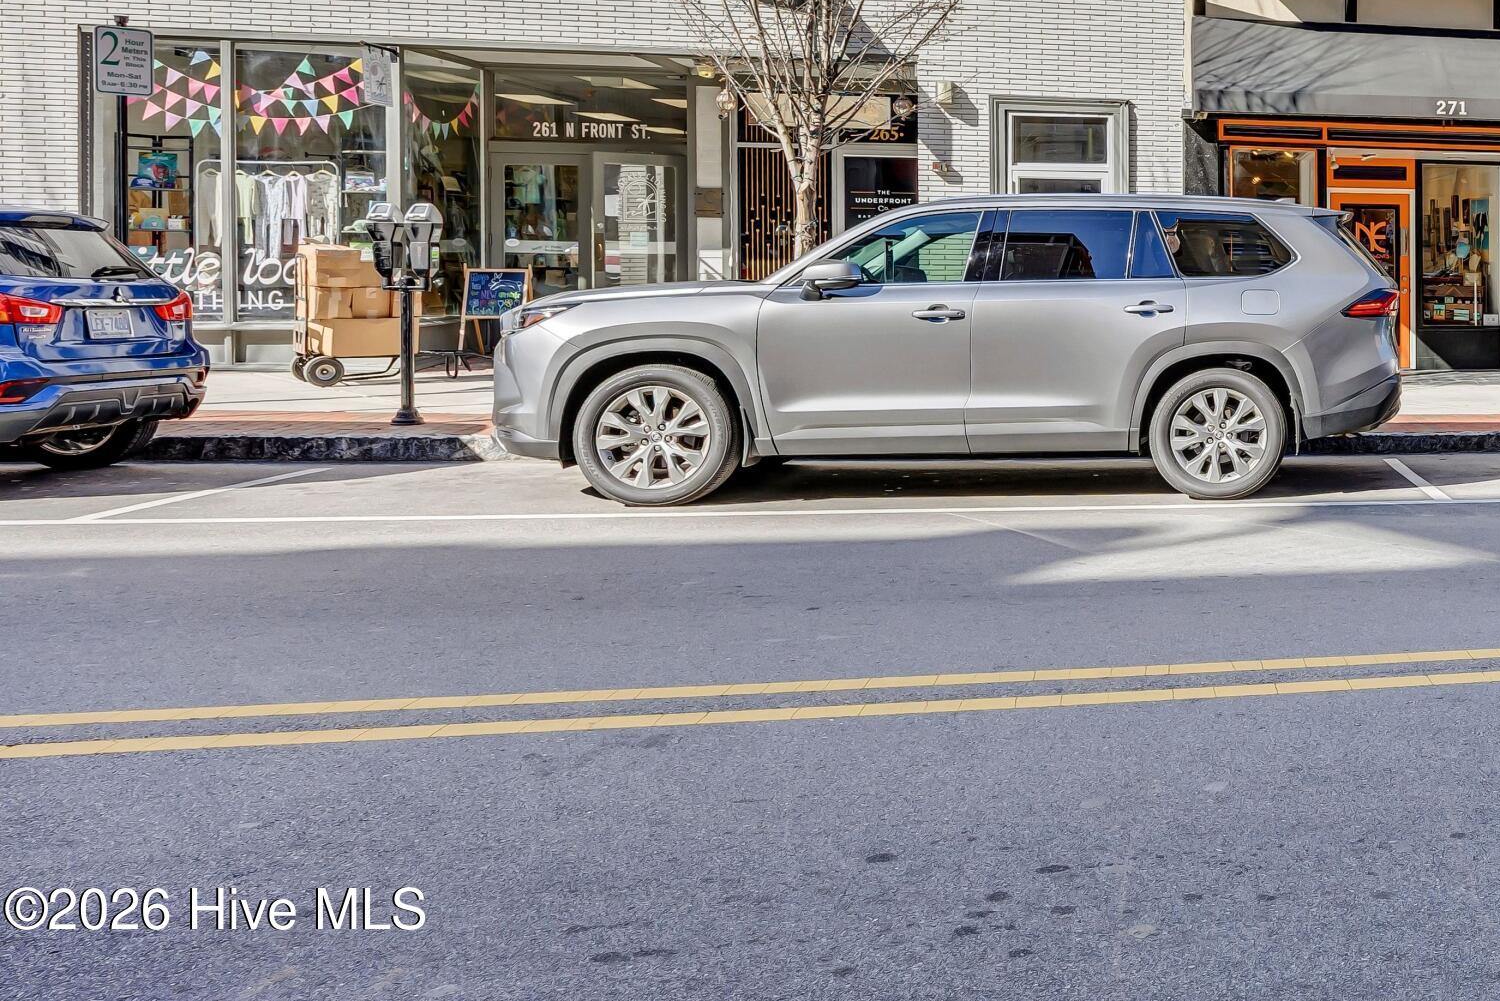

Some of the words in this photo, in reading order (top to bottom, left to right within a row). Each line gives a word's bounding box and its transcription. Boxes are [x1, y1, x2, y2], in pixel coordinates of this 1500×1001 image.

[100, 31, 120, 65] 2
[121, 46, 148, 55] Meters
[107, 72, 142, 80] Mon-Sat
[1436, 100, 1467, 115] 271
[532, 122, 559, 137] 261
[565, 122, 575, 137] N
[581, 123, 624, 139] FRONT
[631, 124, 651, 139] ST.
[869, 127, 899, 140] 265
[138, 247, 222, 285] ttle
